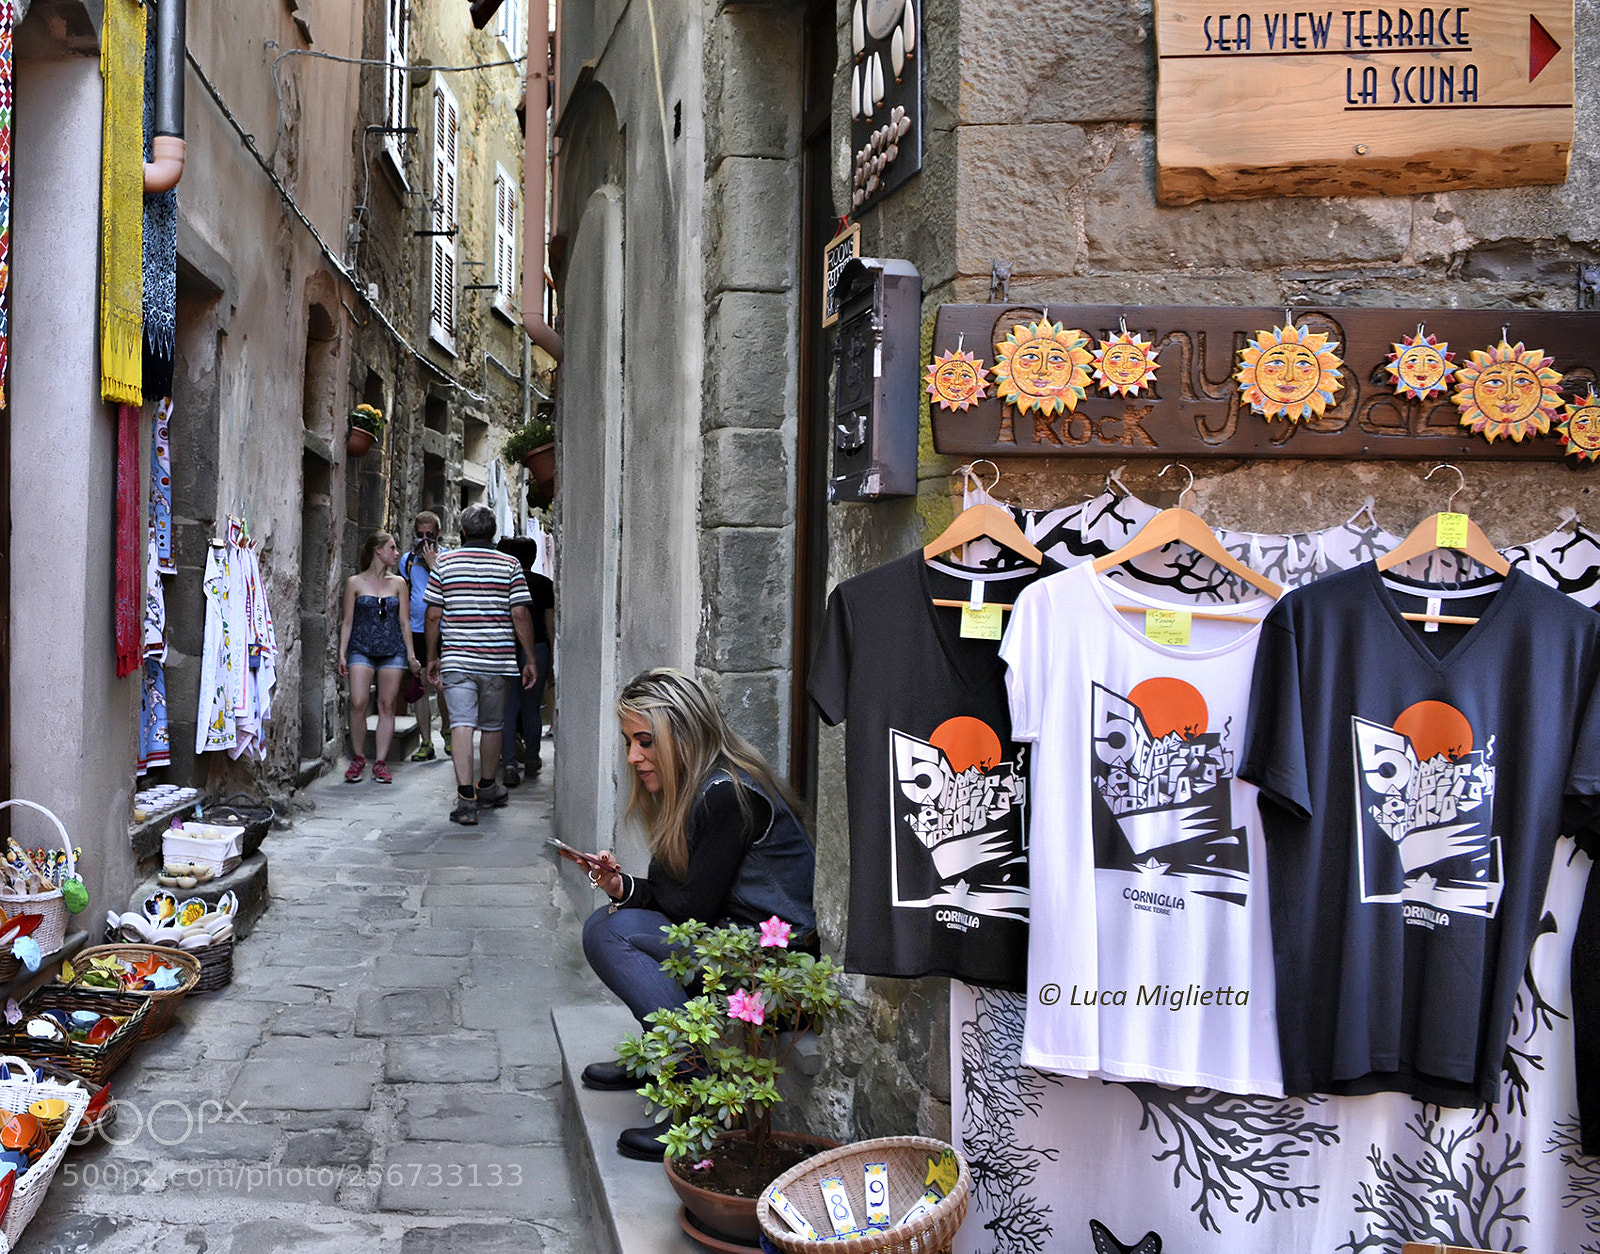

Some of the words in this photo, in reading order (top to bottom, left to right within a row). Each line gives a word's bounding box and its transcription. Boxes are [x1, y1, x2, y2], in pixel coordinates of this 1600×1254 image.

[1203, 14, 1251, 51] SEA
[1264, 12, 1333, 50] VIEW
[1343, 7, 1470, 48] TERRACE
[1346, 66, 1378, 104] LA
[1391, 64, 1478, 103] SCUNA
[1032, 405, 1159, 448] ROCK
[1093, 685, 1138, 766] 5
[894, 733, 945, 804] 5
[1355, 720, 1412, 794] 5
[1122, 887, 1185, 910] CORNIGLIA
[831, 1194, 850, 1221] 8
[869, 1180, 886, 1208] 9
